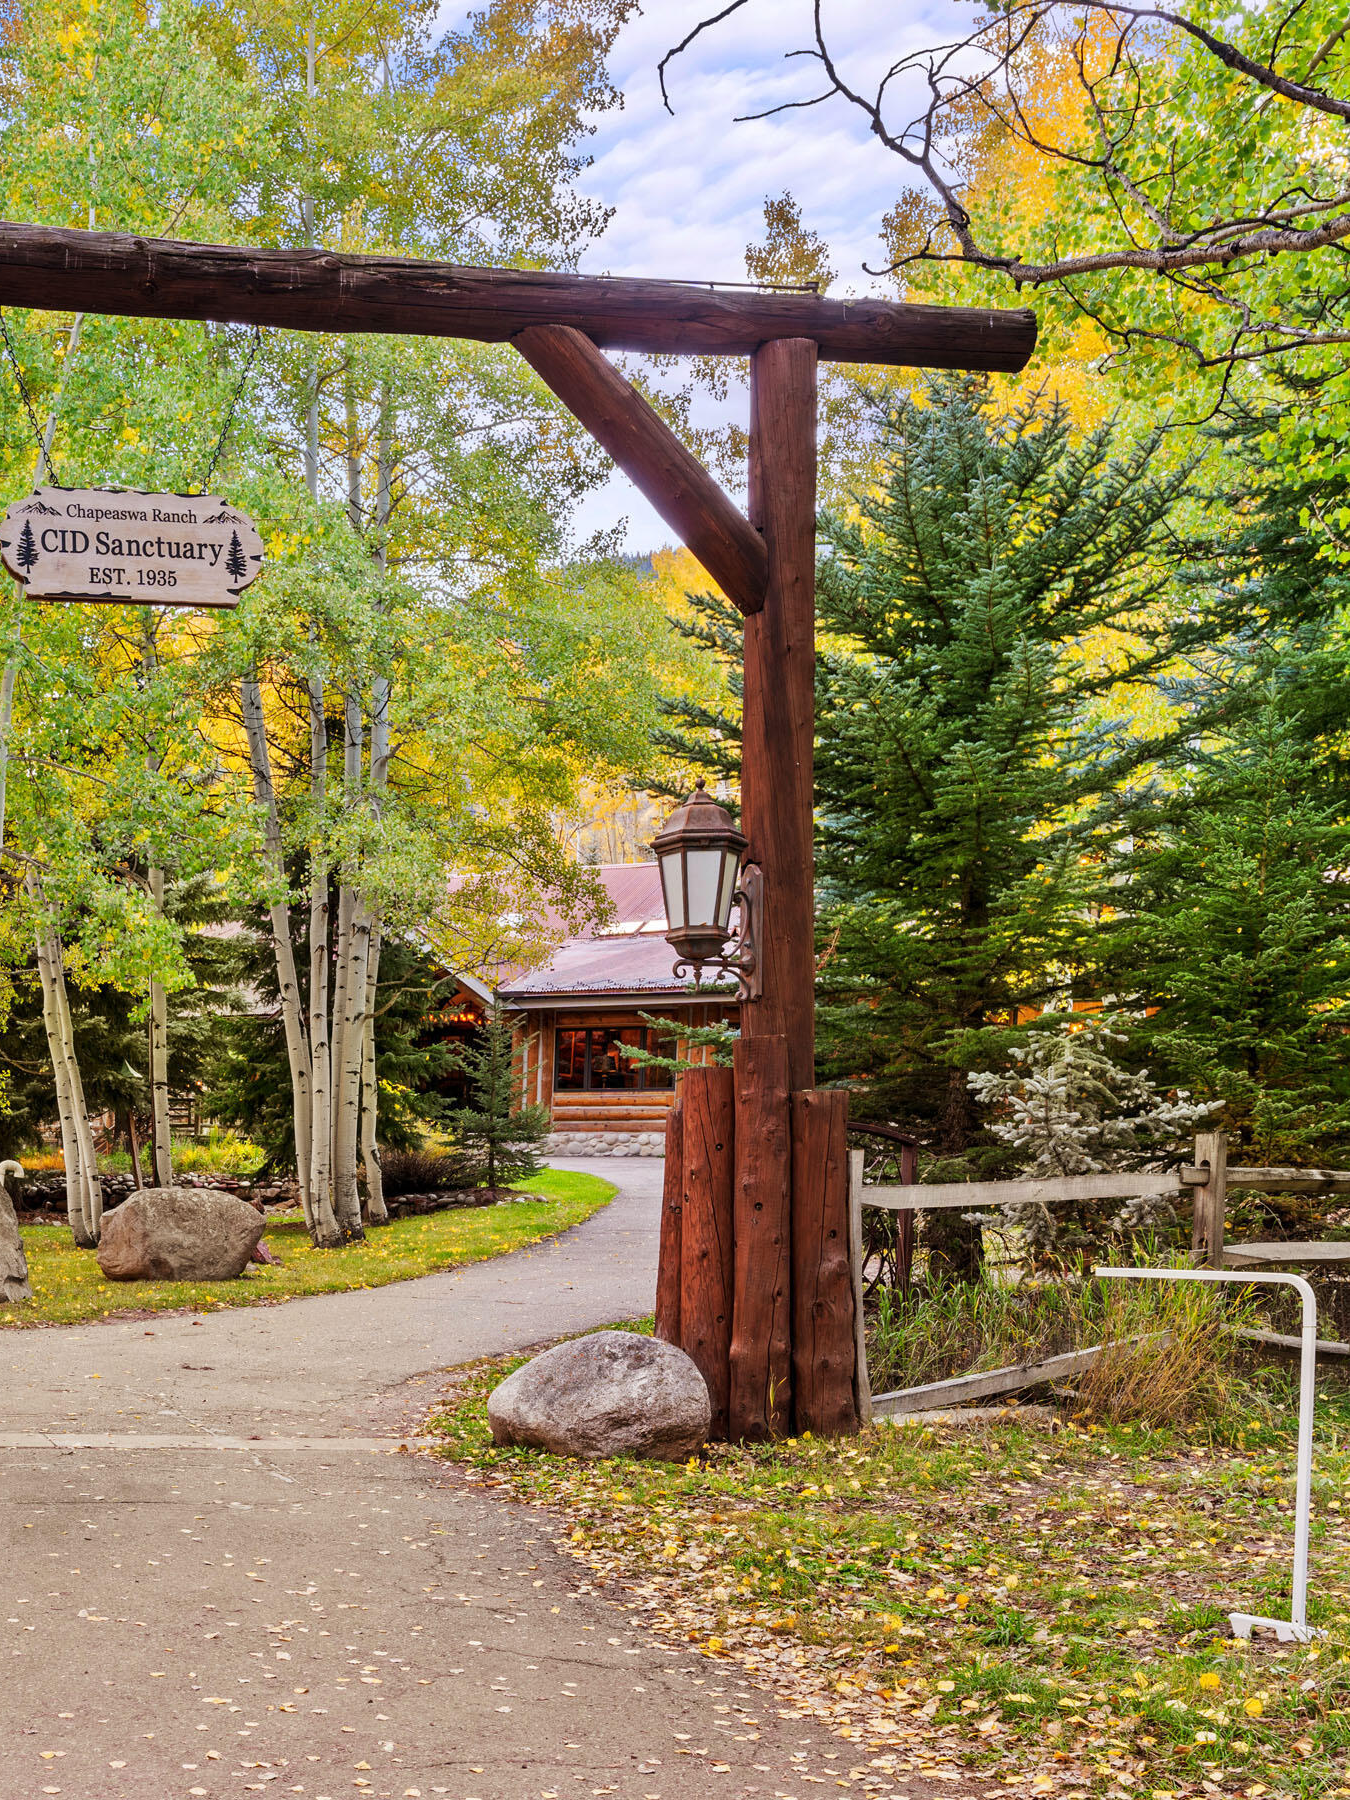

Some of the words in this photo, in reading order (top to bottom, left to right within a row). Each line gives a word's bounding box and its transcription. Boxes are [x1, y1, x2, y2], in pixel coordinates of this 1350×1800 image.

[66, 503, 148, 522] Chapeaswa
[152, 508, 197, 524] Ranch
[41, 528, 90, 554] CID
[96, 531, 224, 567] Sanctuary
[89, 566, 131, 586] EST.
[137, 569, 178, 587] 1935
